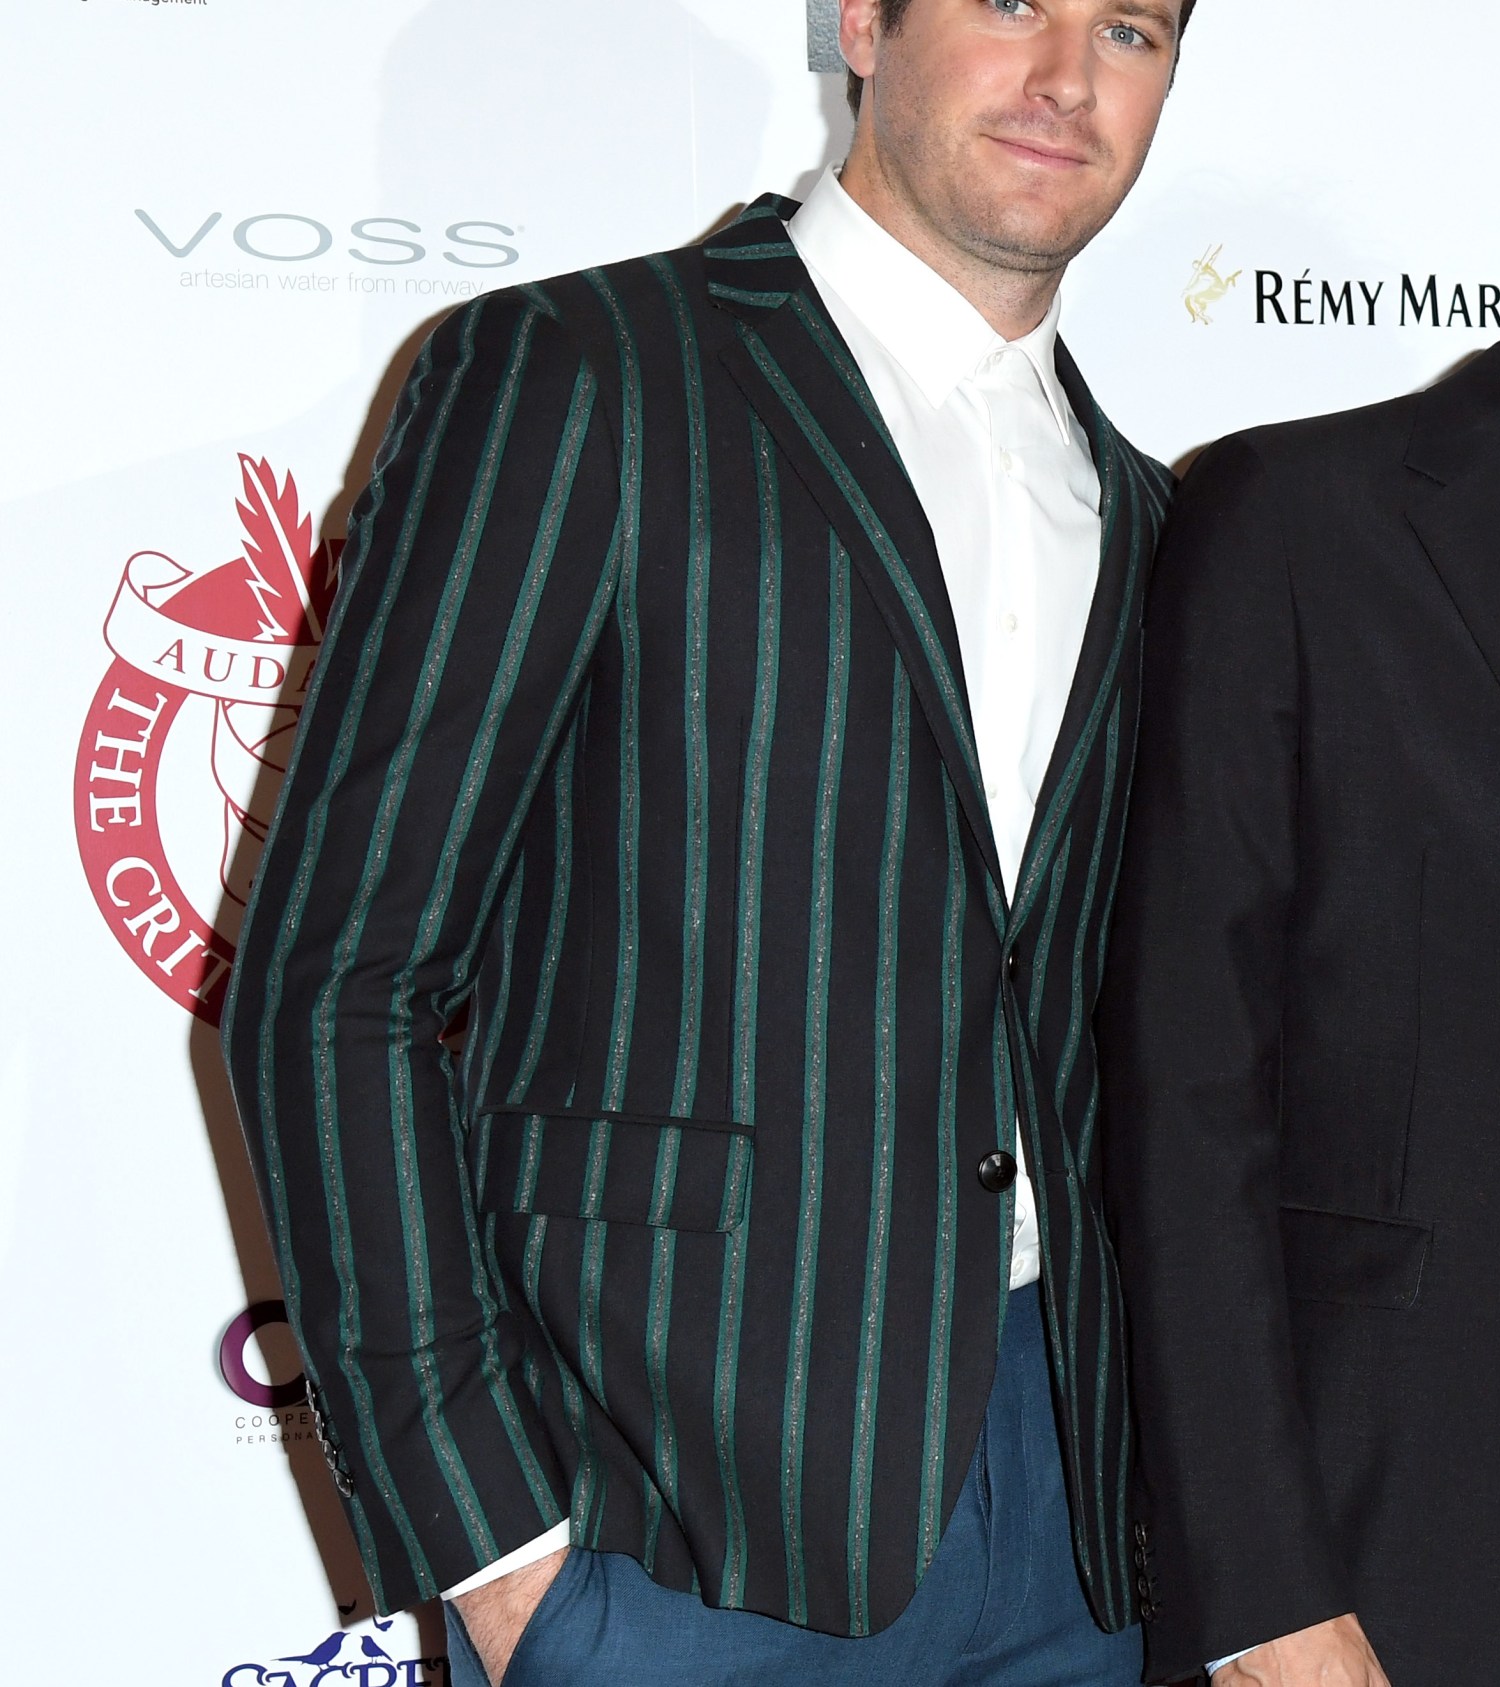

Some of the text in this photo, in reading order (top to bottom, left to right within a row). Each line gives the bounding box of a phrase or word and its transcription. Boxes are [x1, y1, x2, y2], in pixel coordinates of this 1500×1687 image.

[134, 208, 520, 268] VOSS
[179, 268, 484, 297] artesian water from norway
[1254, 268, 1385, 326] RÉMY
[89, 687, 168, 832] THE
[235, 1412, 316, 1429] COOPE
